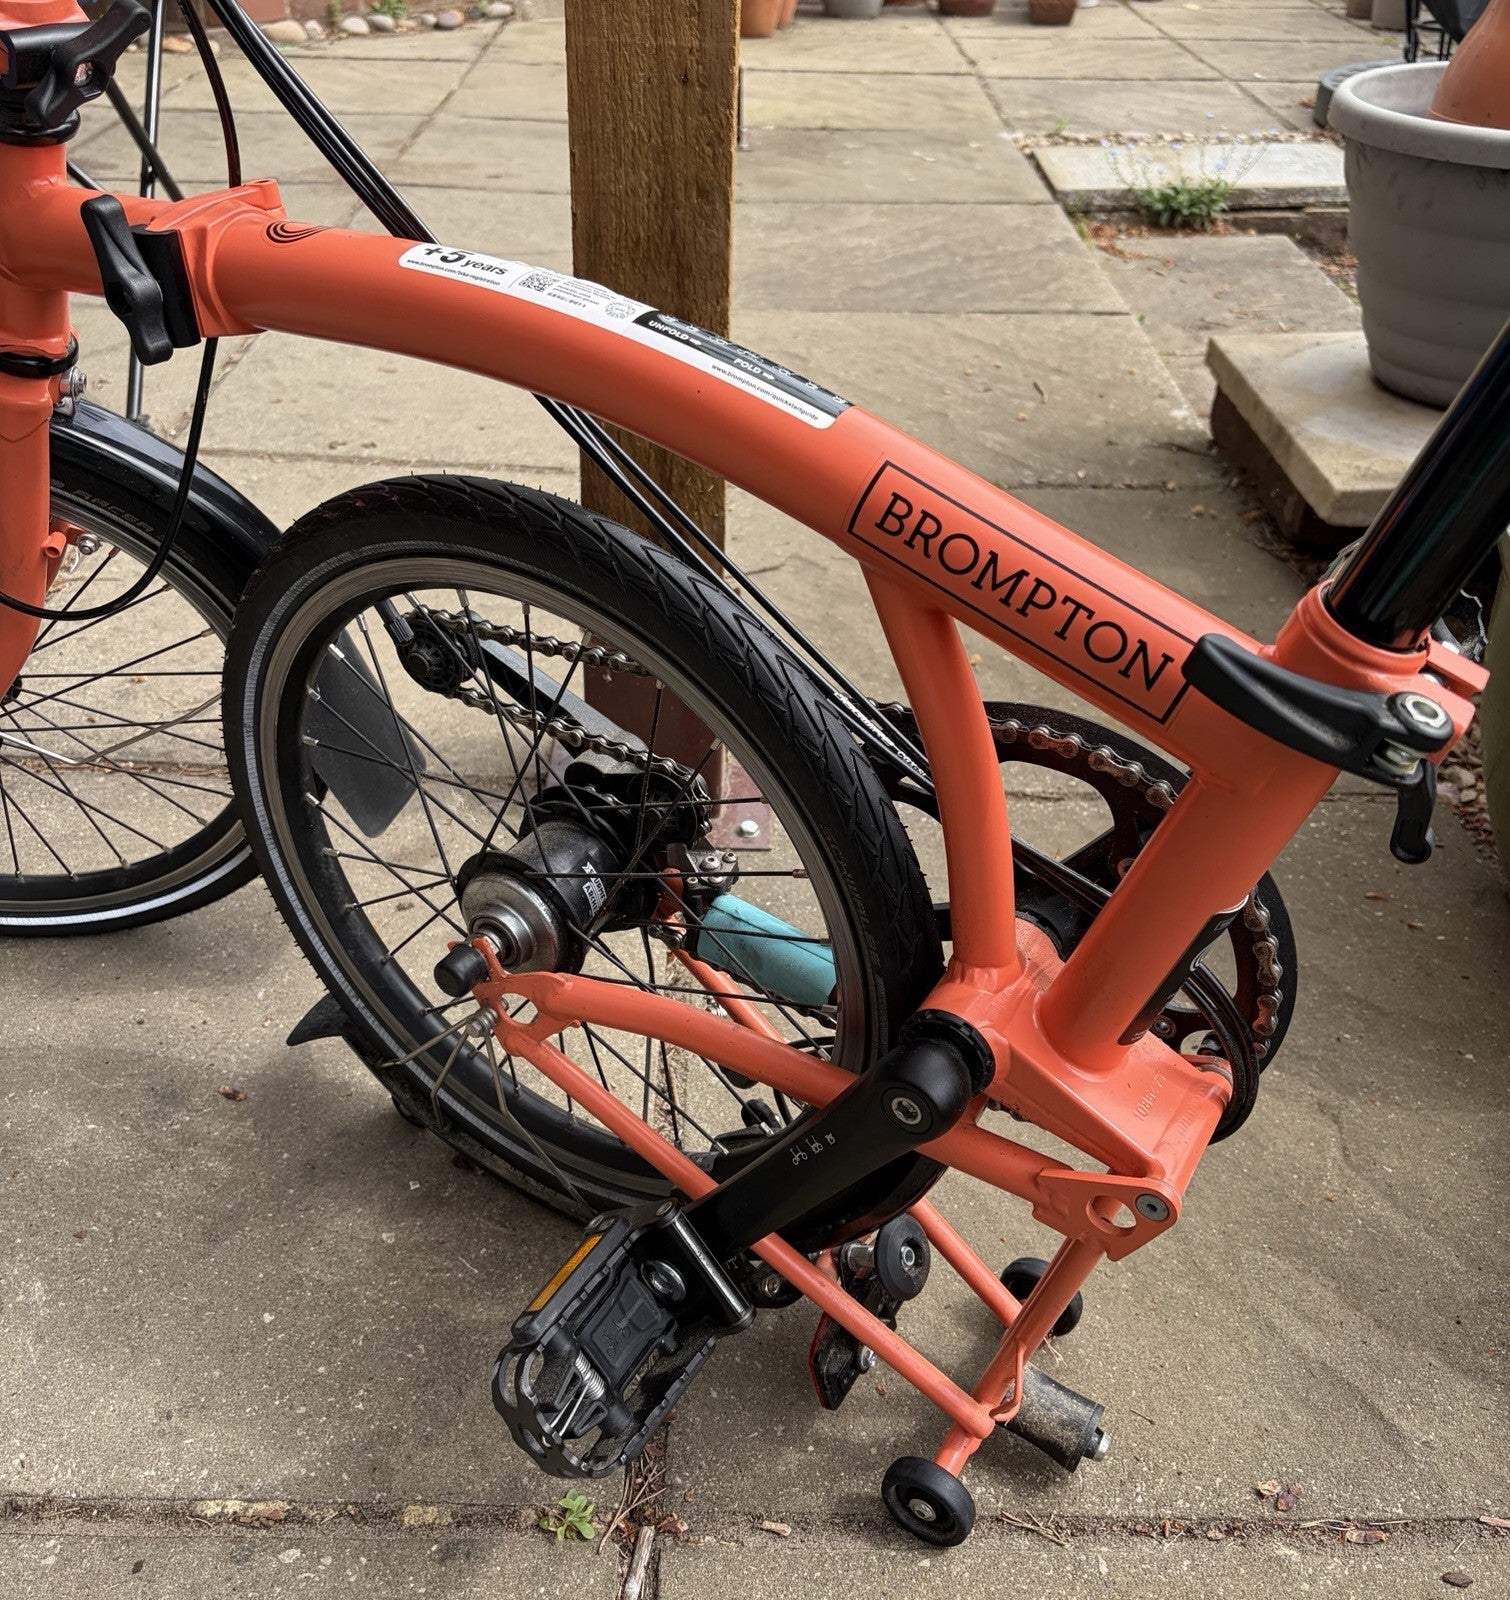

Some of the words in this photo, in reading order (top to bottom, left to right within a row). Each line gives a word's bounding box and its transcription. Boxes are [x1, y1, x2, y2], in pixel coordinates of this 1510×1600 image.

[460, 259, 508, 275] years
[648, 320, 690, 341] UNFOLD
[733, 358, 762, 375] FOLD
[711, 364, 819, 421] www.brompton.com/quickstartguide
[875, 492, 1175, 692] BROMPTON
